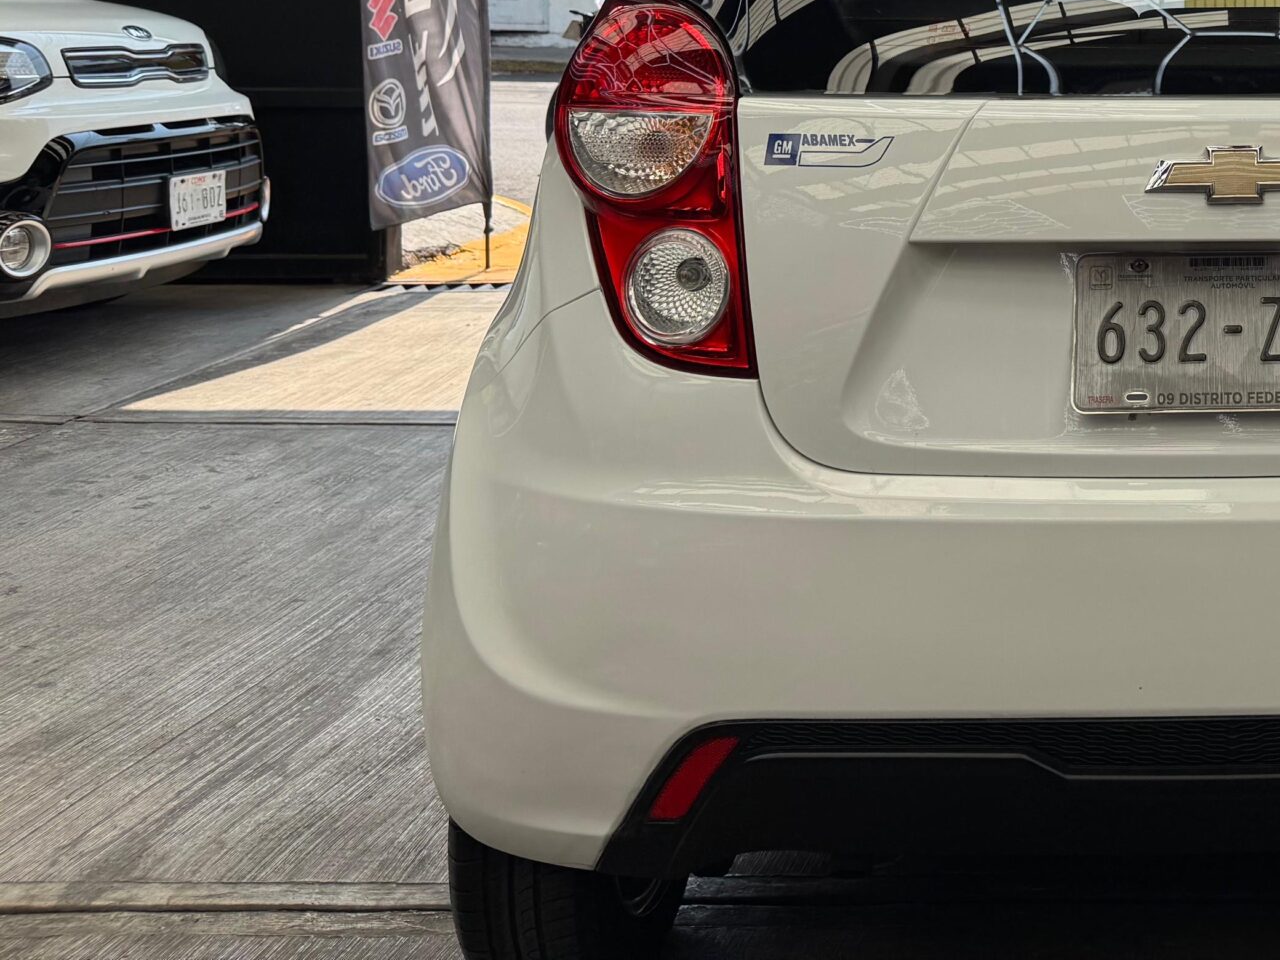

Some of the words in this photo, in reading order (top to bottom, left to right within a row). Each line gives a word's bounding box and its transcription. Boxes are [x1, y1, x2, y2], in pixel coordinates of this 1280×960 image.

[773, 140, 792, 154] GM
[801, 133, 857, 147] ABAMEX
[1157, 392, 1174, 405] 09
[1179, 391, 1243, 405] DISTRITO
